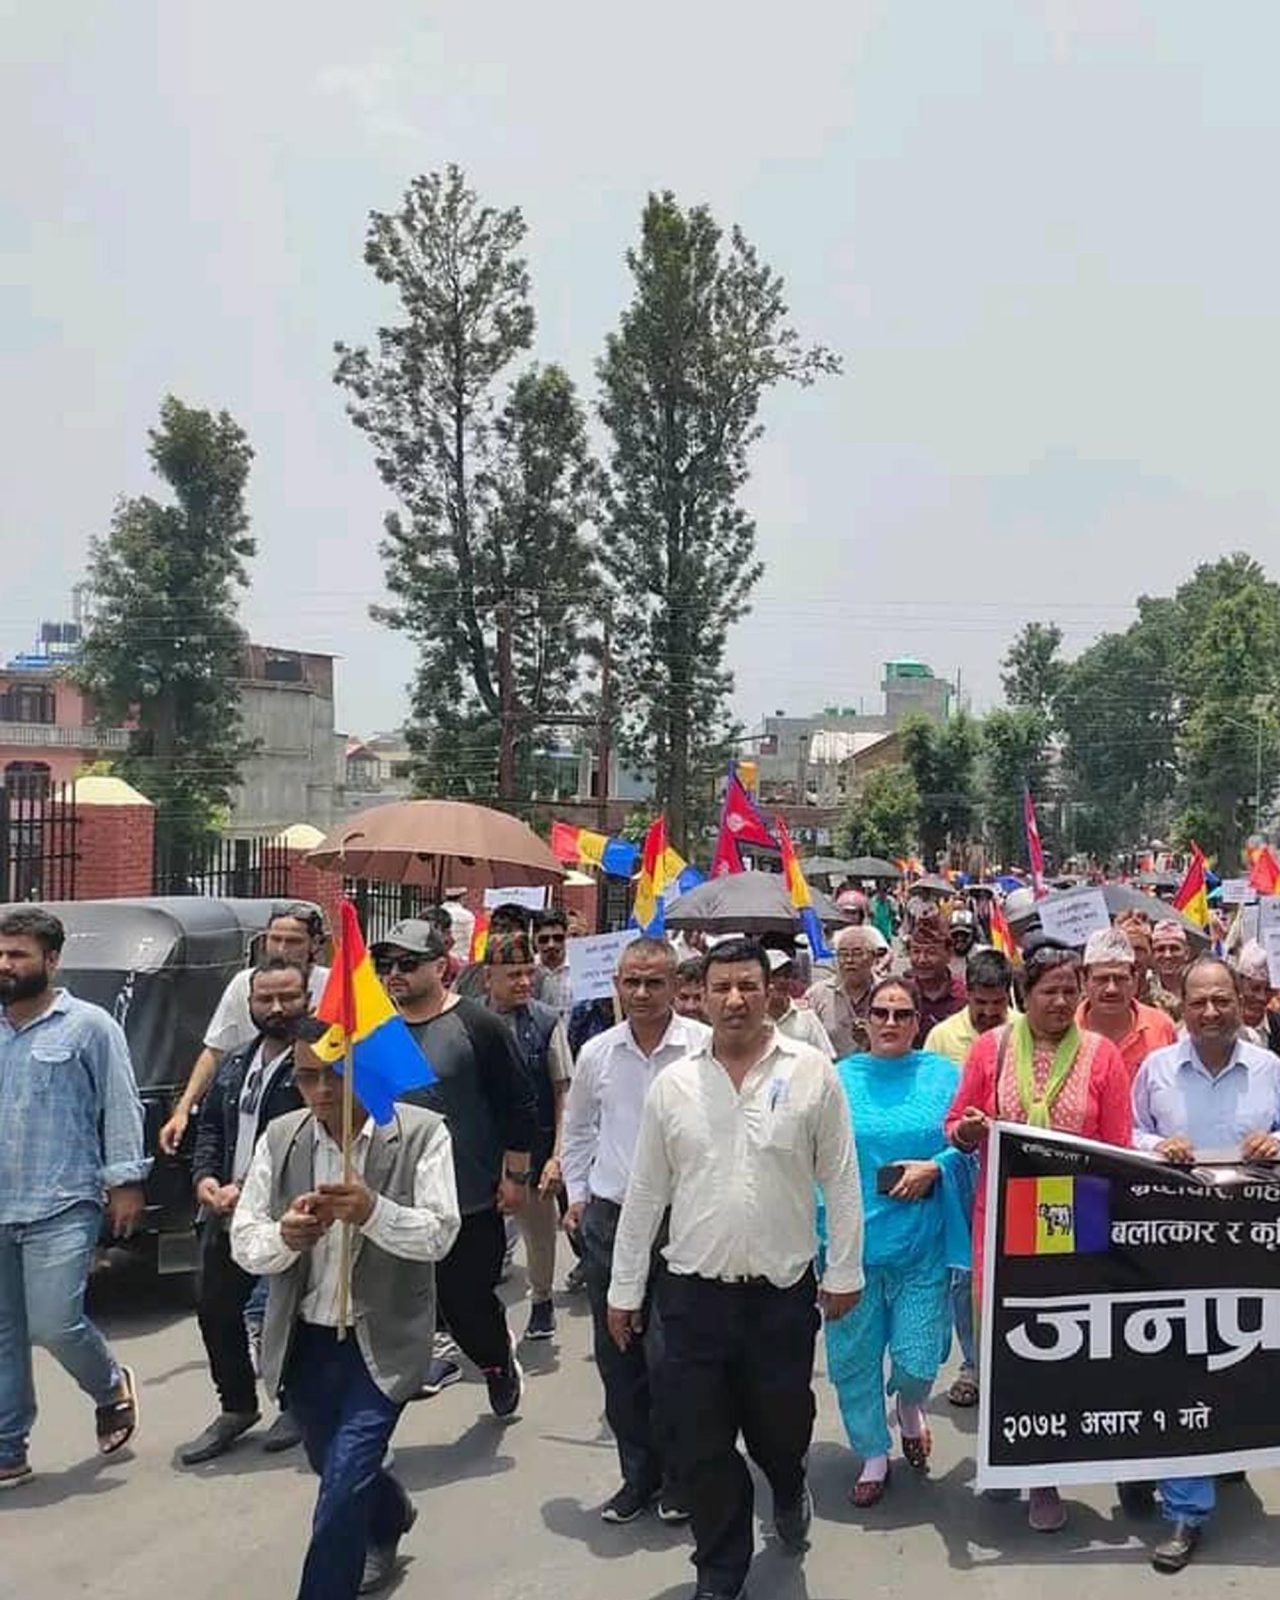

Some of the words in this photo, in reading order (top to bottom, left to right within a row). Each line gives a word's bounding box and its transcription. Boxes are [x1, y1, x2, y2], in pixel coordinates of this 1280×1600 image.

[1111, 1220, 1219, 1245] बलात्कार
[1226, 1221, 1244, 1243] र
[1003, 1413, 1067, 1443] २०७९
[1080, 1410, 1142, 1434] असार
[1153, 1410, 1165, 1431] १
[1179, 1402, 1211, 1429] गते
